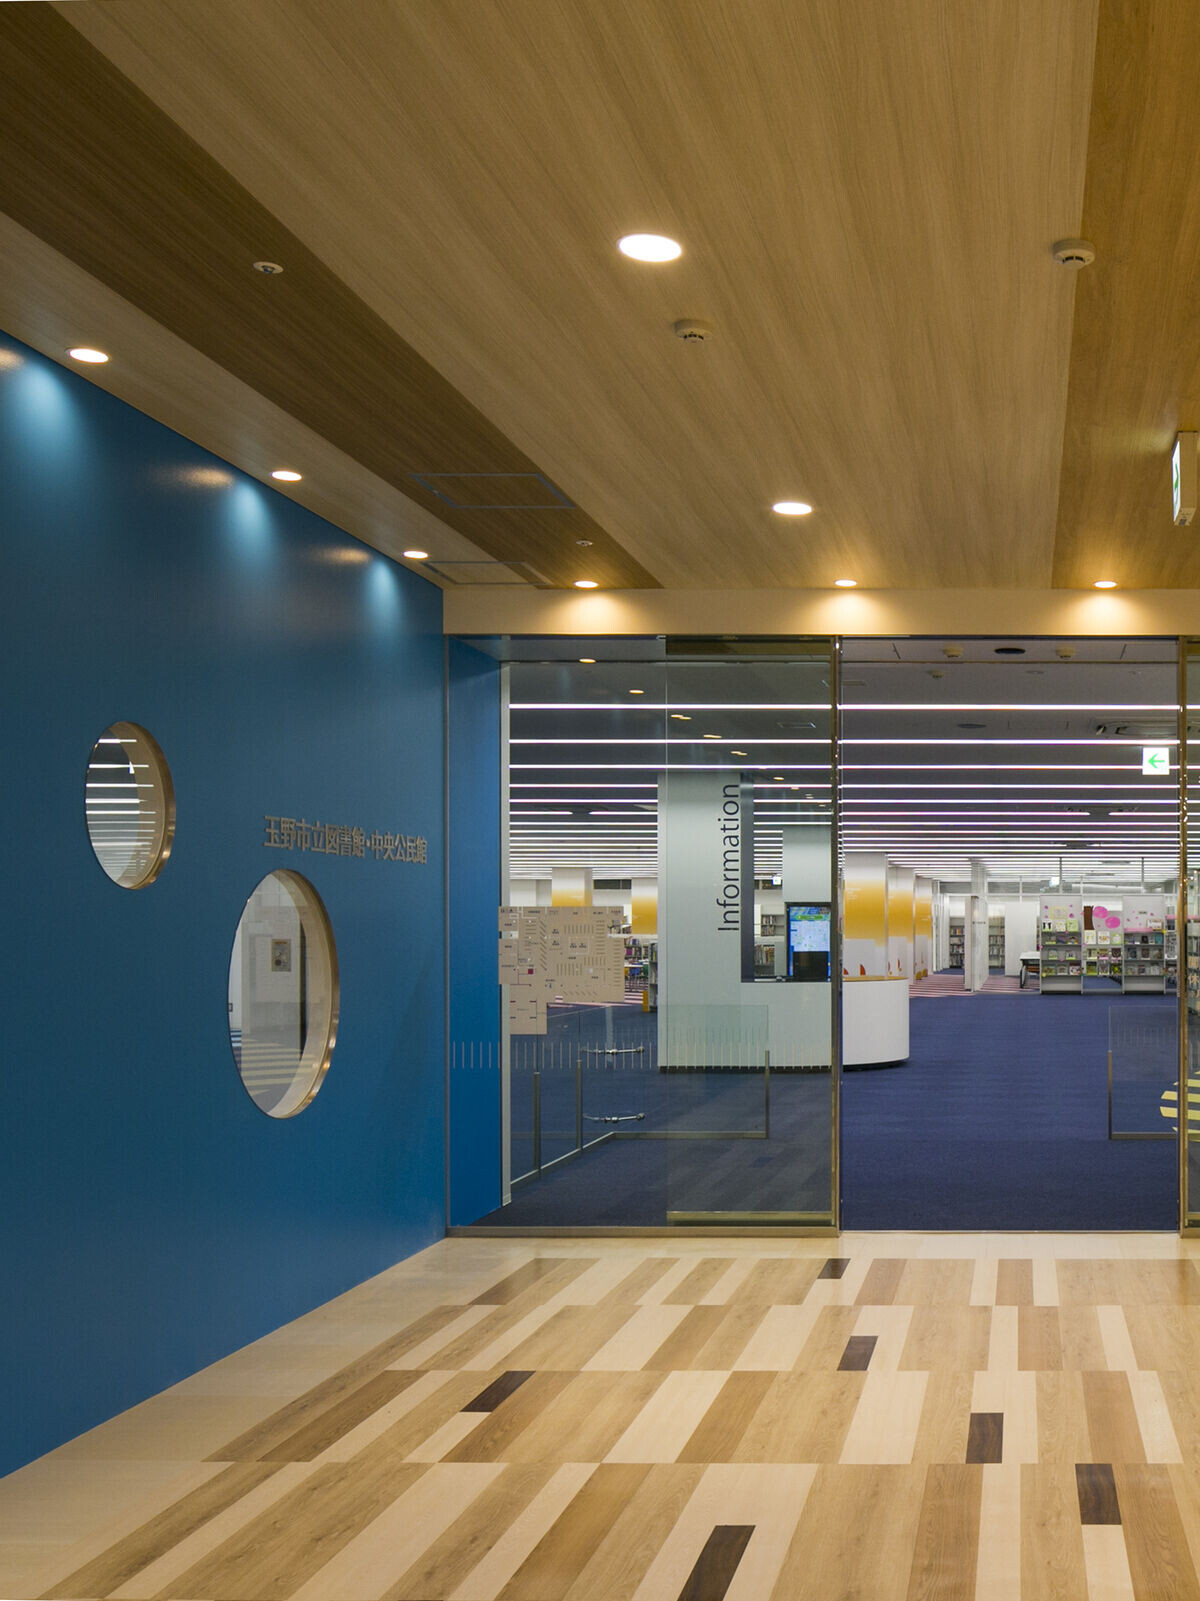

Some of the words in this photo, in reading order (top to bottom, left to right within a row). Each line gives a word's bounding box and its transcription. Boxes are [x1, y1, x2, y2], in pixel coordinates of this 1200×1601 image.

[264, 815, 427, 864] 玉野市立図書館・中央公民館
[716, 783, 740, 931] Information
